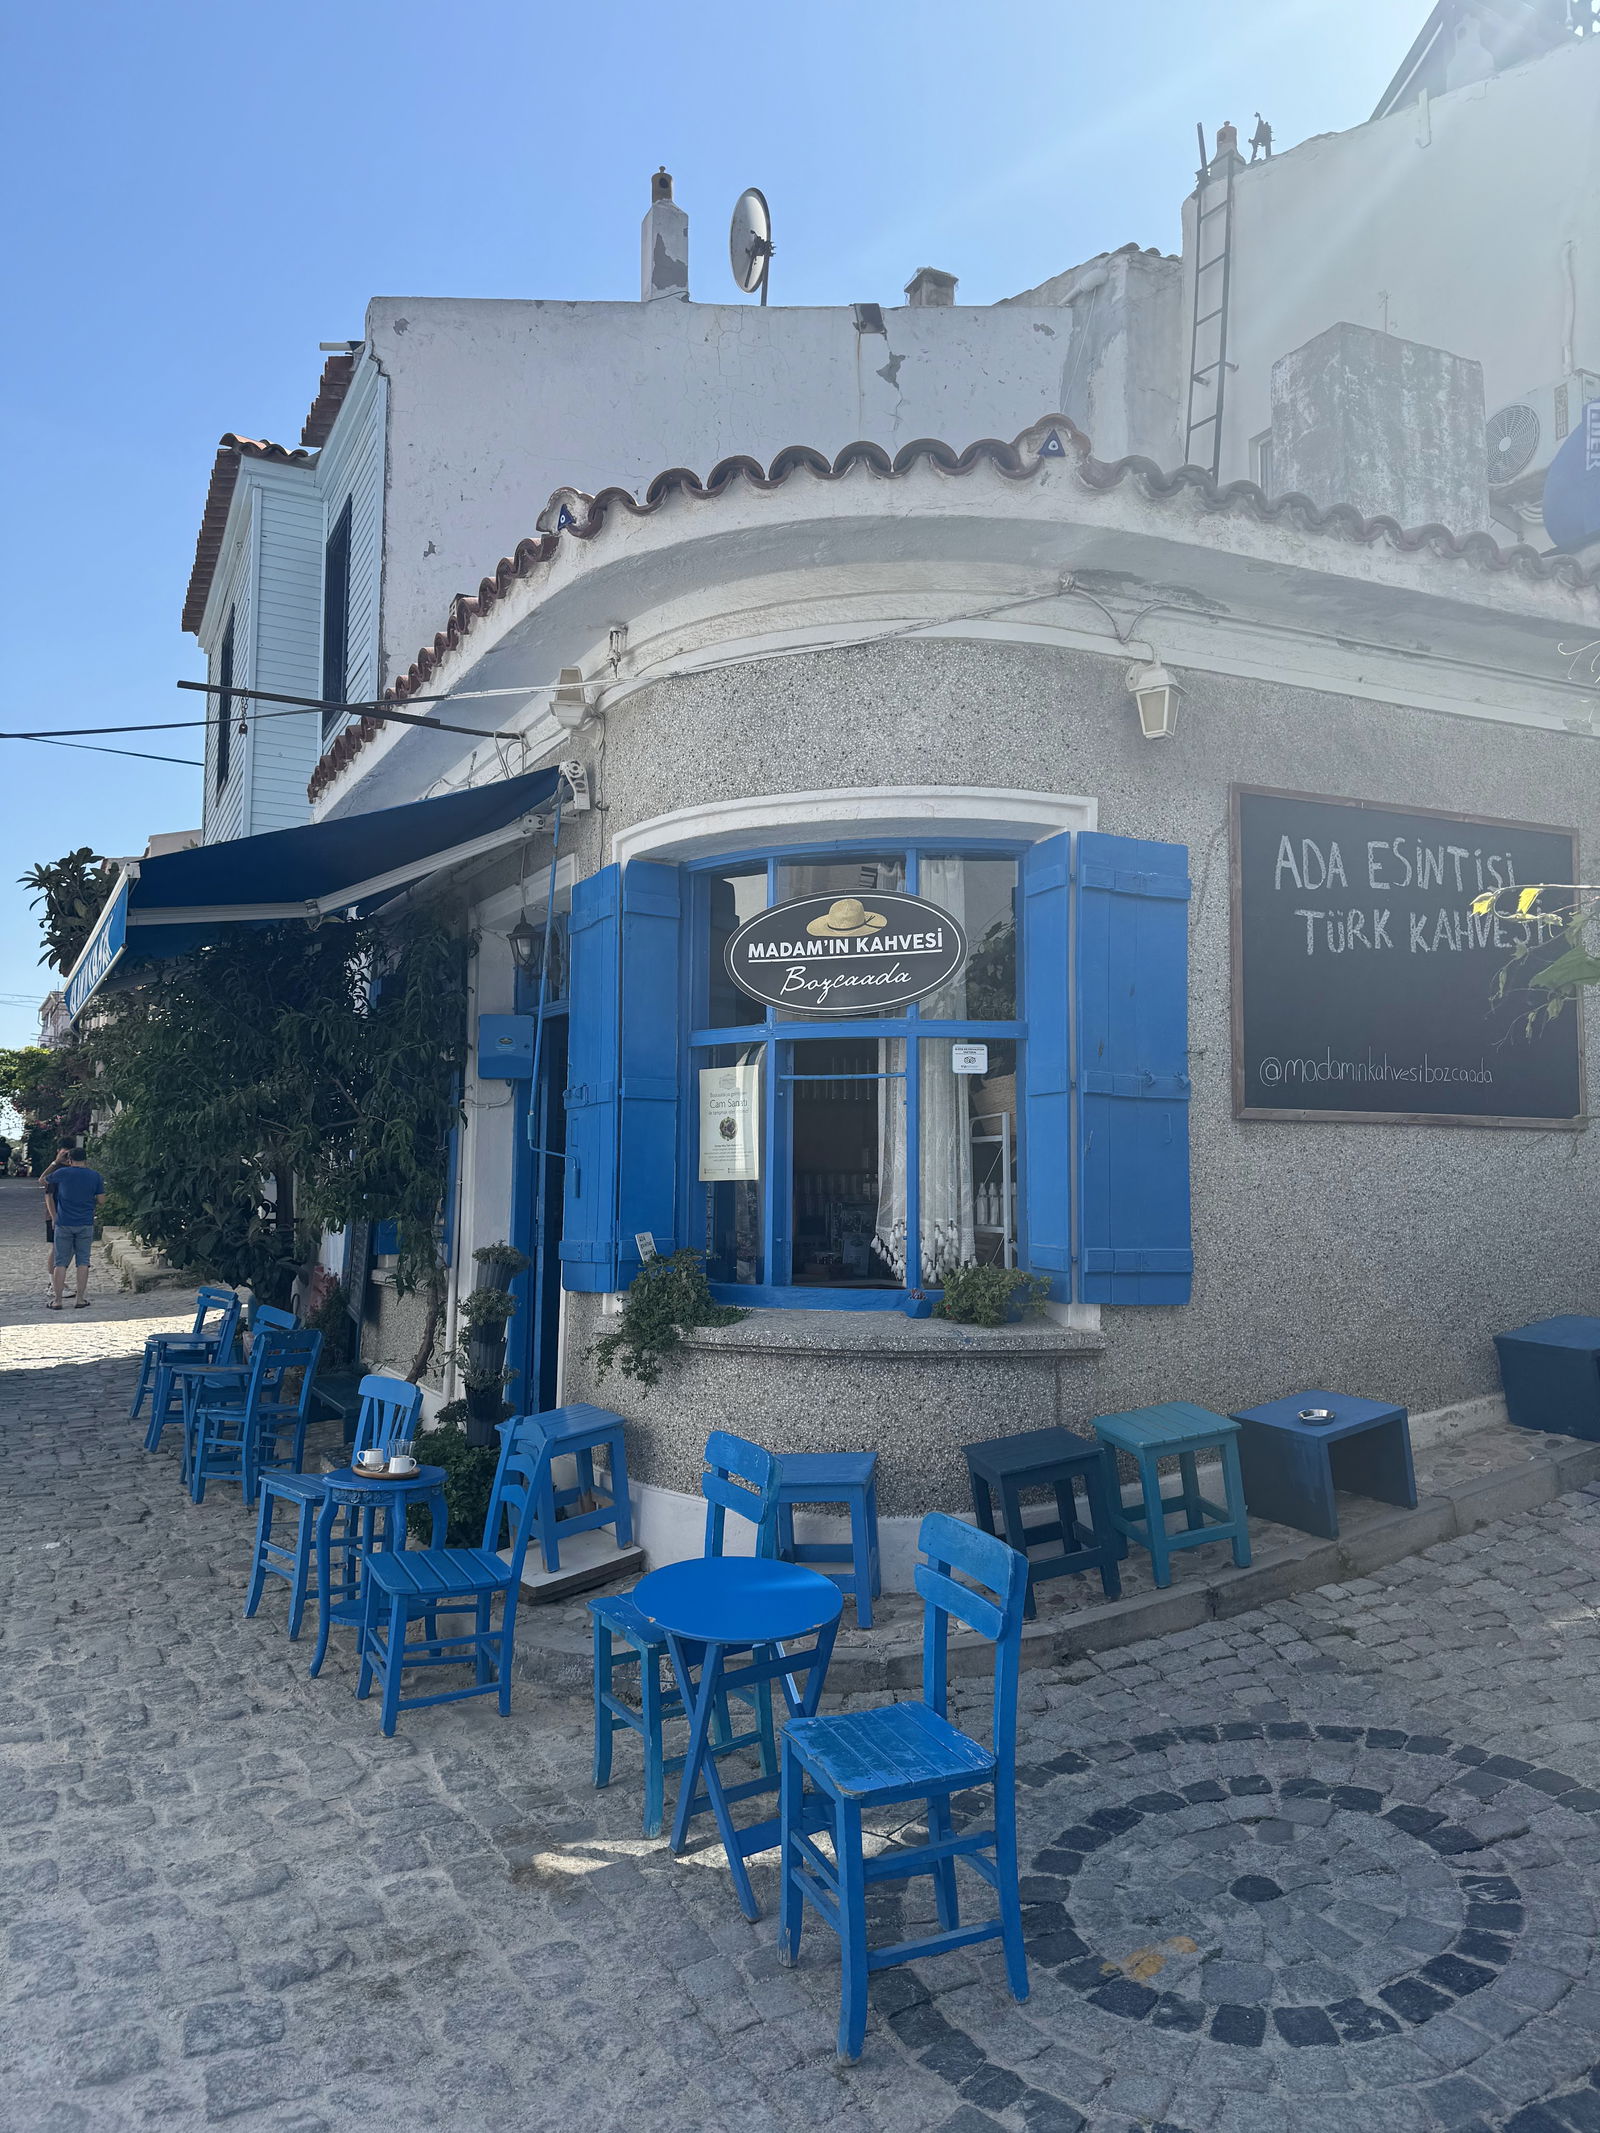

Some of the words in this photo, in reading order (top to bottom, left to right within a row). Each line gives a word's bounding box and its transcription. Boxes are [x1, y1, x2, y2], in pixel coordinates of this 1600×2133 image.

[1275, 834, 1348, 890] ADA
[856, 928, 943, 953] KAHVESİ
[1294, 908, 1394, 955] TÜRK
[780, 962, 911, 1004] Bozcaada
[709, 1099, 726, 1109] Cam
